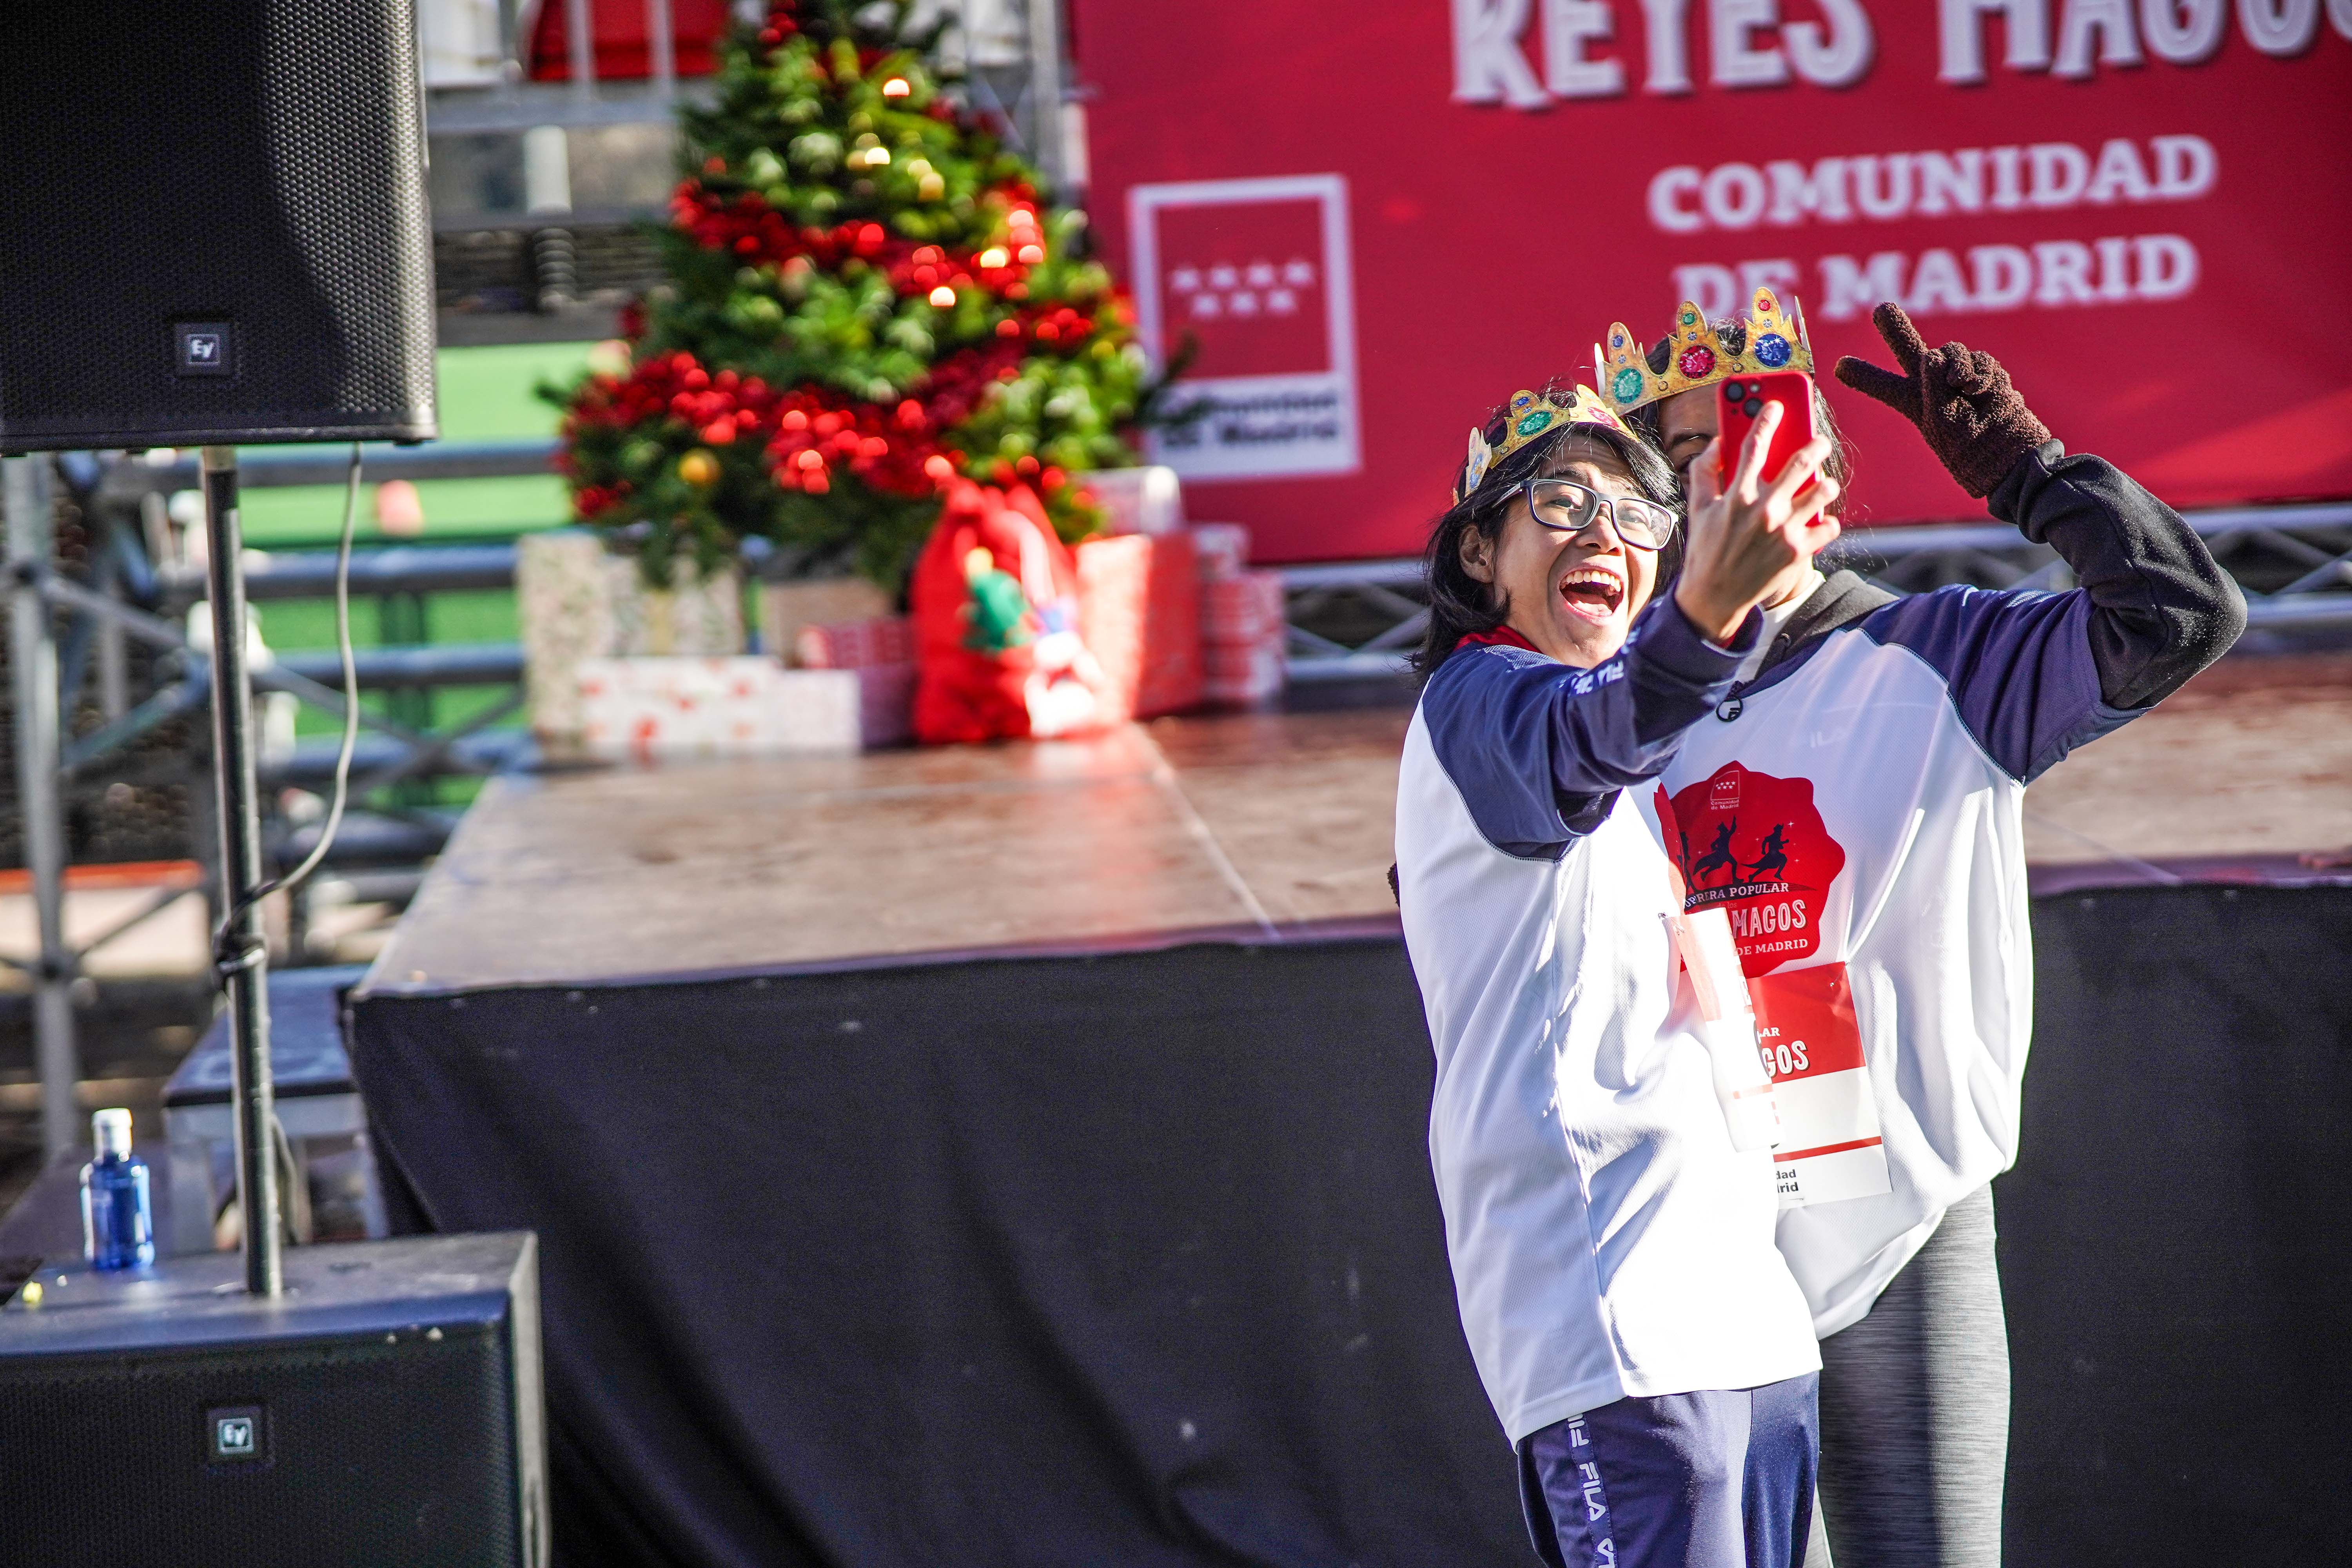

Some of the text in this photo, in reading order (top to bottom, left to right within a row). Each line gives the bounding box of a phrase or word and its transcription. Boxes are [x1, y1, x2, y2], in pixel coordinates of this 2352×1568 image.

[1649, 135, 2217, 231] COMUNIDAD
[1818, 236, 2196, 318] MADRID
[1729, 883, 1789, 897] POPULAR
[1731, 899, 1806, 939] MAGOS
[1736, 938, 1808, 956] DE MADRID
[1762, 1040, 1809, 1078] GOS
[1580, 1462, 1606, 1521] FILA
